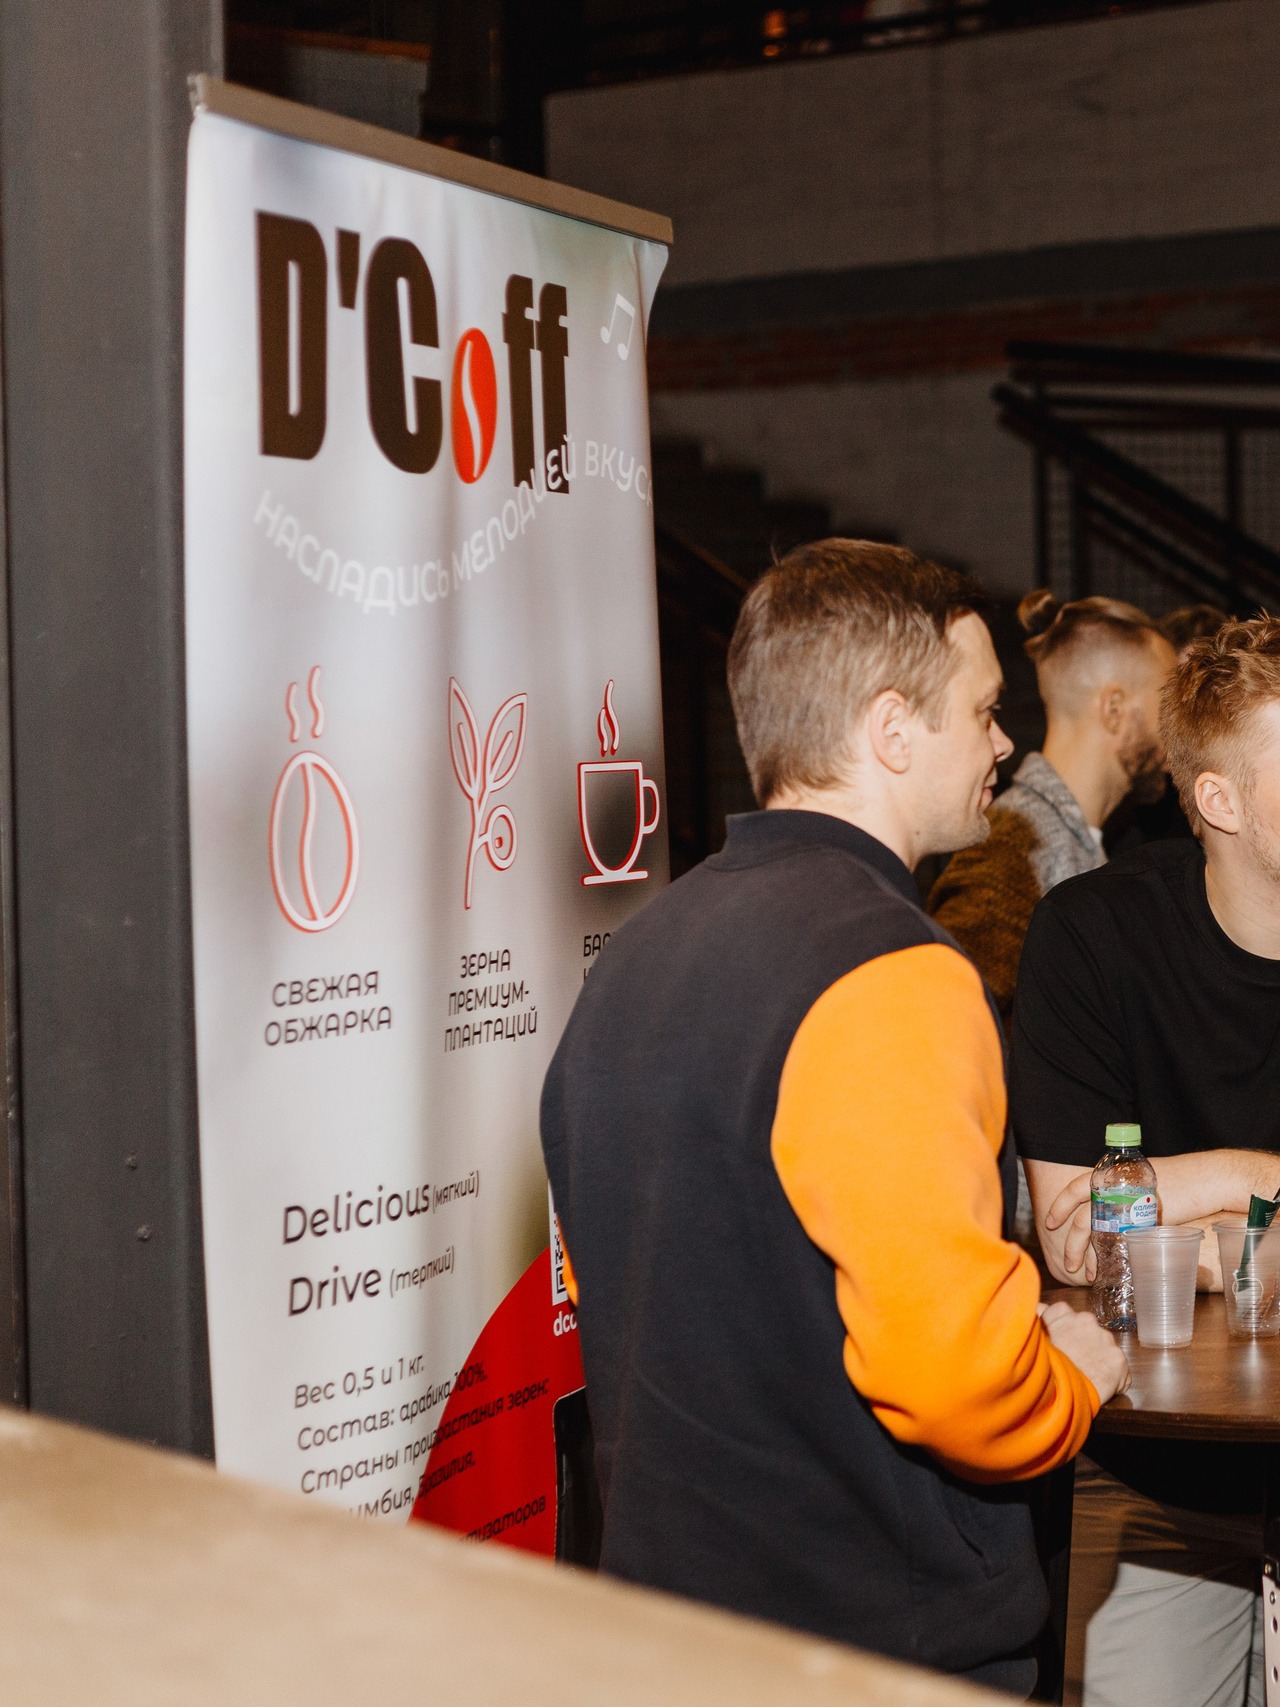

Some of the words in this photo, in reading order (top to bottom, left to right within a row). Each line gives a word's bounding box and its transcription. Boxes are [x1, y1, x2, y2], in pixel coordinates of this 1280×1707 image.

[254, 489, 449, 616] НАСЛАДИСЬ
[452, 433, 577, 590] МЕЛОДИЕЙ
[271, 970, 379, 1008] СВЕЖАЯ
[460, 949, 511, 978] ЗЕРНА
[448, 980, 529, 1016] ПРЕМИУМ-
[264, 1005, 392, 1047] ОБЖАРКА
[444, 1006, 538, 1053] ПЛАНТАЦИЙ
[282, 1184, 430, 1245] Delicious
[432, 1170, 480, 1214] (мягкий)
[288, 1265, 382, 1317] Drive
[390, 1245, 455, 1298] (терпкий)
[294, 1381, 335, 1409] Вес
[342, 1366, 375, 1397] 0,5
[381, 1366, 392, 1385] и
[398, 1357, 404, 1381] 1
[408, 1354, 424, 1378] кг.
[297, 1408, 395, 1451] Состав:
[400, 1380, 451, 1424] арабика
[300, 1449, 399, 1494] Страны
[403, 1397, 504, 1465] произрастания
[507, 1378, 549, 1410] зерен:
